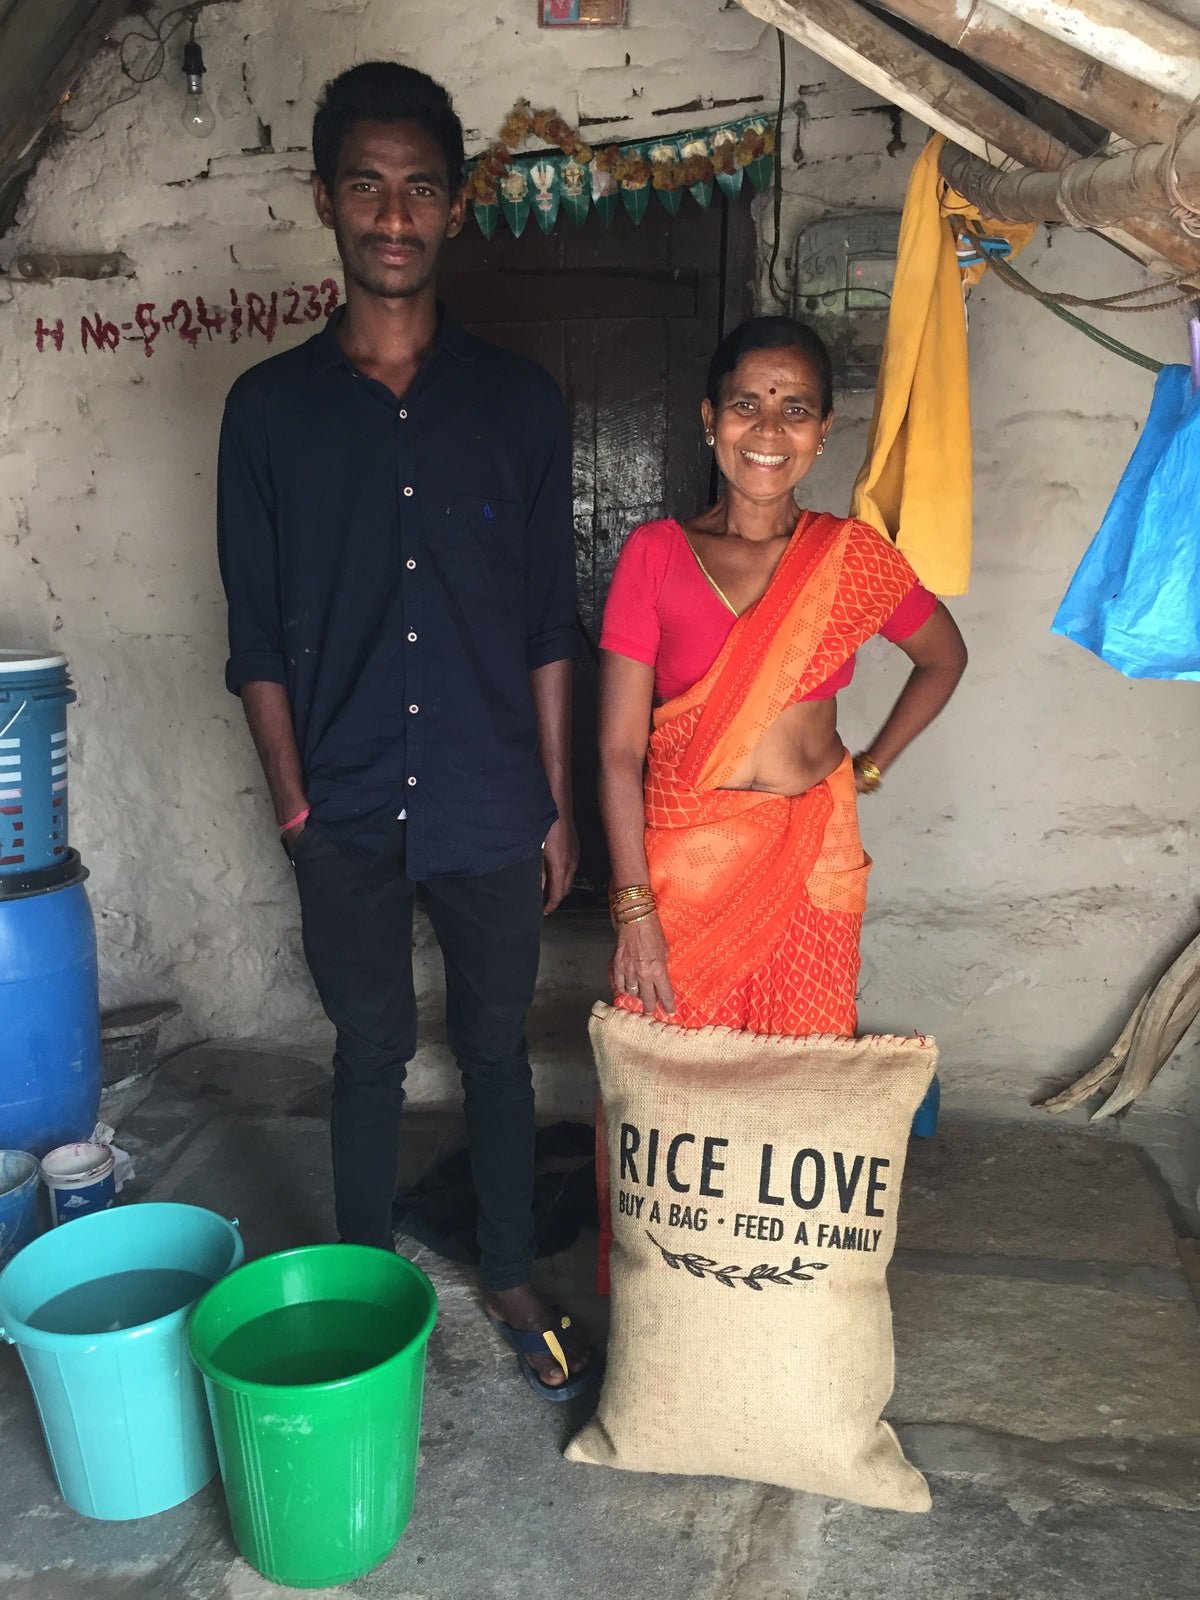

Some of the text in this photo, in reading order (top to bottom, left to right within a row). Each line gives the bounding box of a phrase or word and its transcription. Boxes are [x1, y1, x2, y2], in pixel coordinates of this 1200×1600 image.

[35, 317, 64, 352] H
[620, 1122, 890, 1218] RICE LOVE
[619, 1190, 882, 1253] BUY A BAG FEED A FAMILY
